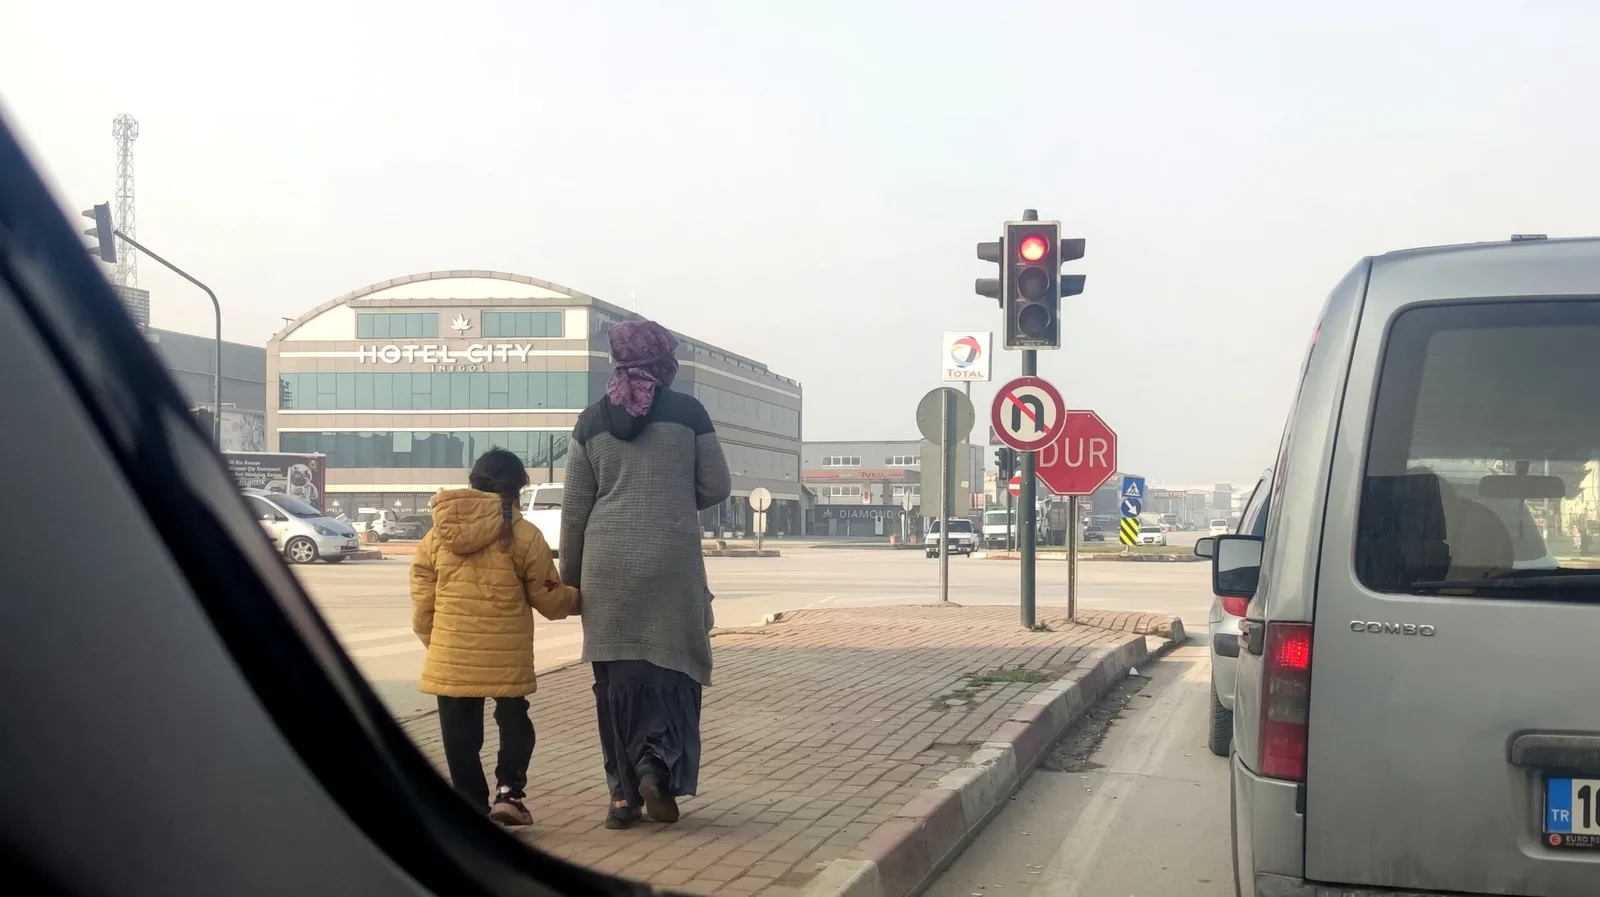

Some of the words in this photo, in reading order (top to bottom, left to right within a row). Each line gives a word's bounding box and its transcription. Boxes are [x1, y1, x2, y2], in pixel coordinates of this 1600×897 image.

[359, 344, 457, 364] HOTEL
[466, 343, 533, 363] CITY
[946, 368, 985, 378] TOTAL
[1039, 437, 1108, 468] DUR
[839, 509, 894, 518] DIAMOND
[898, 509, 921, 518] CY
[1349, 620, 1436, 636] COMBO
[1551, 808, 1570, 822] TR
[1565, 835, 1589, 843] EURO
